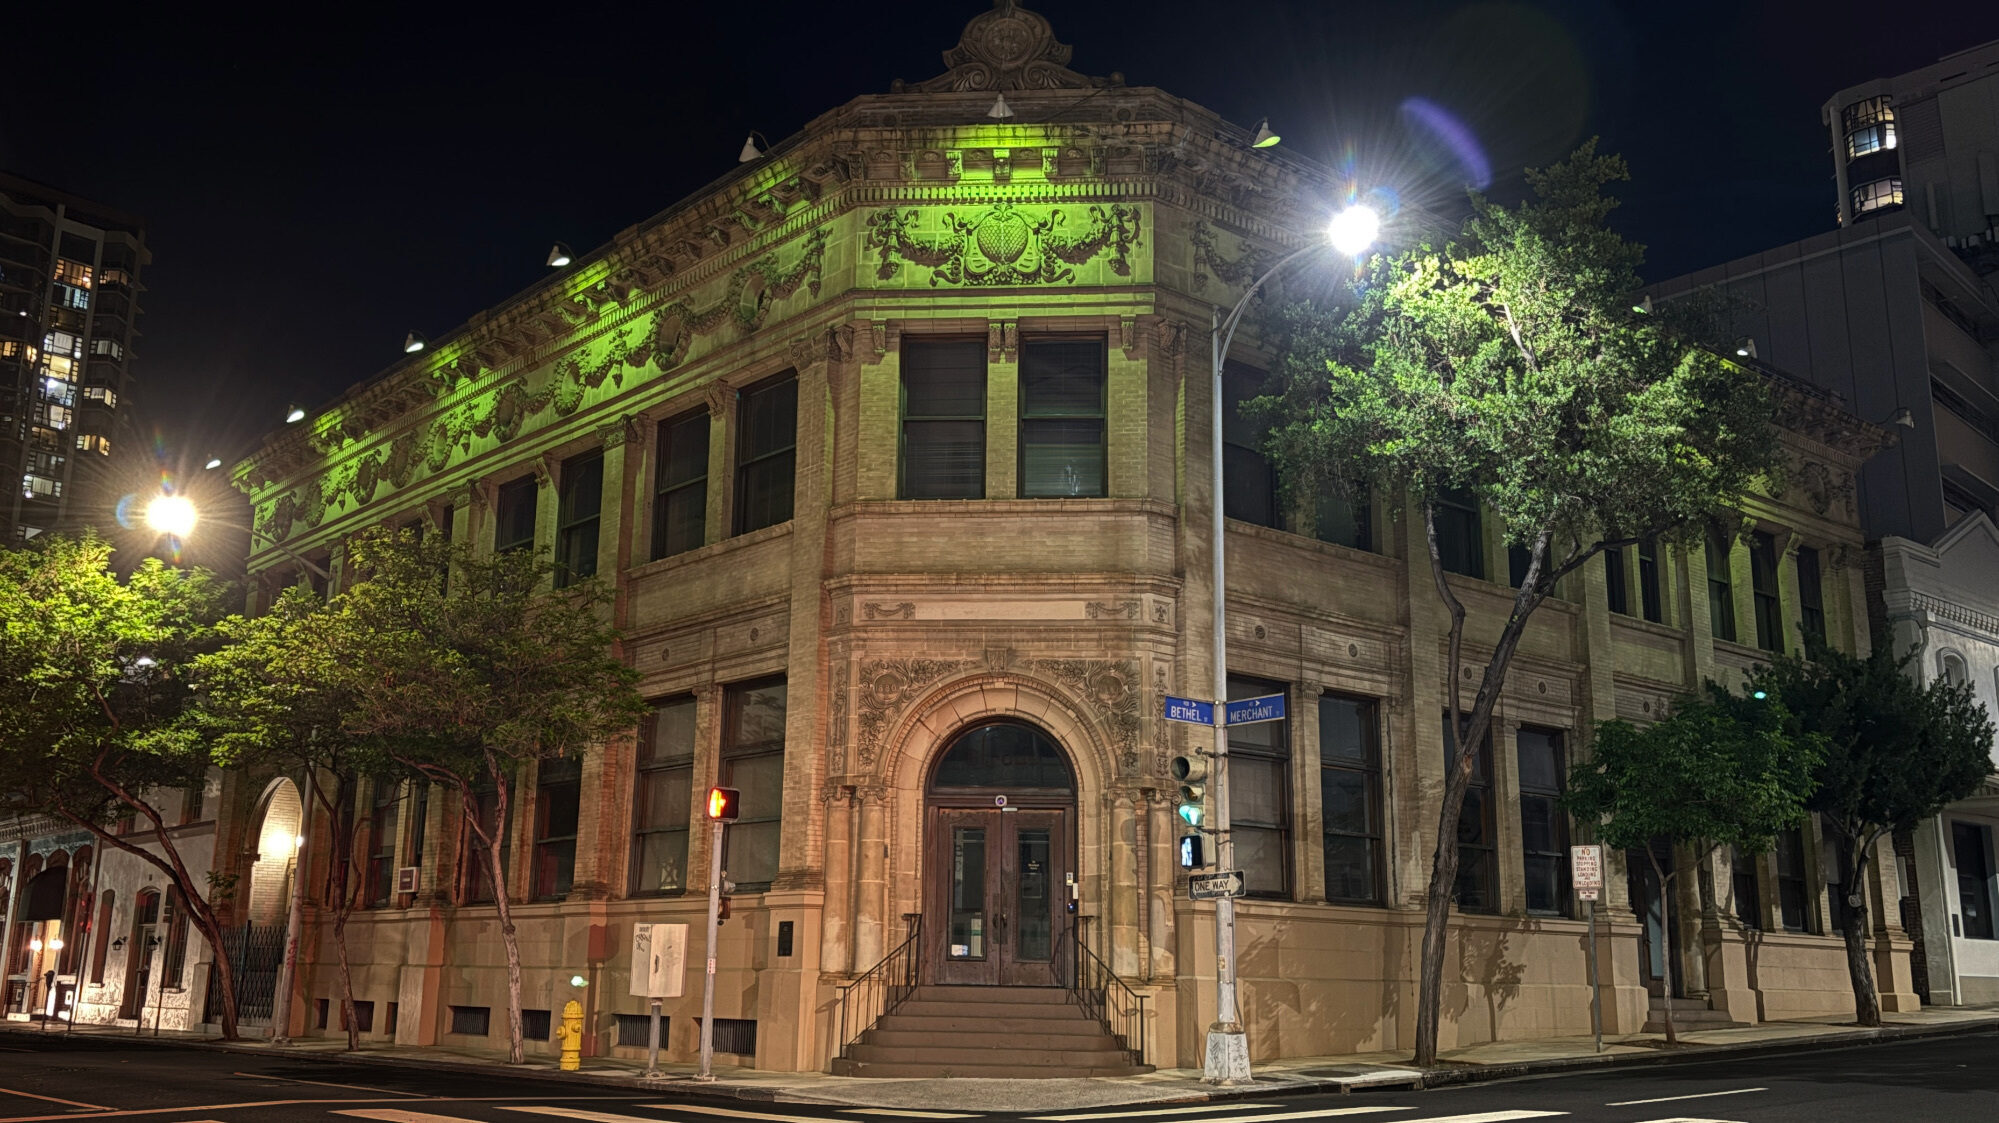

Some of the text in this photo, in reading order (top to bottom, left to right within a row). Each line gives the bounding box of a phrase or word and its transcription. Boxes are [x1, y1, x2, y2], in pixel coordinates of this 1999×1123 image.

[1171, 706, 1202, 721] BETHEL
[1230, 706, 1273, 722] MERCHANT
[1194, 879, 1229, 891] ONE WAY
